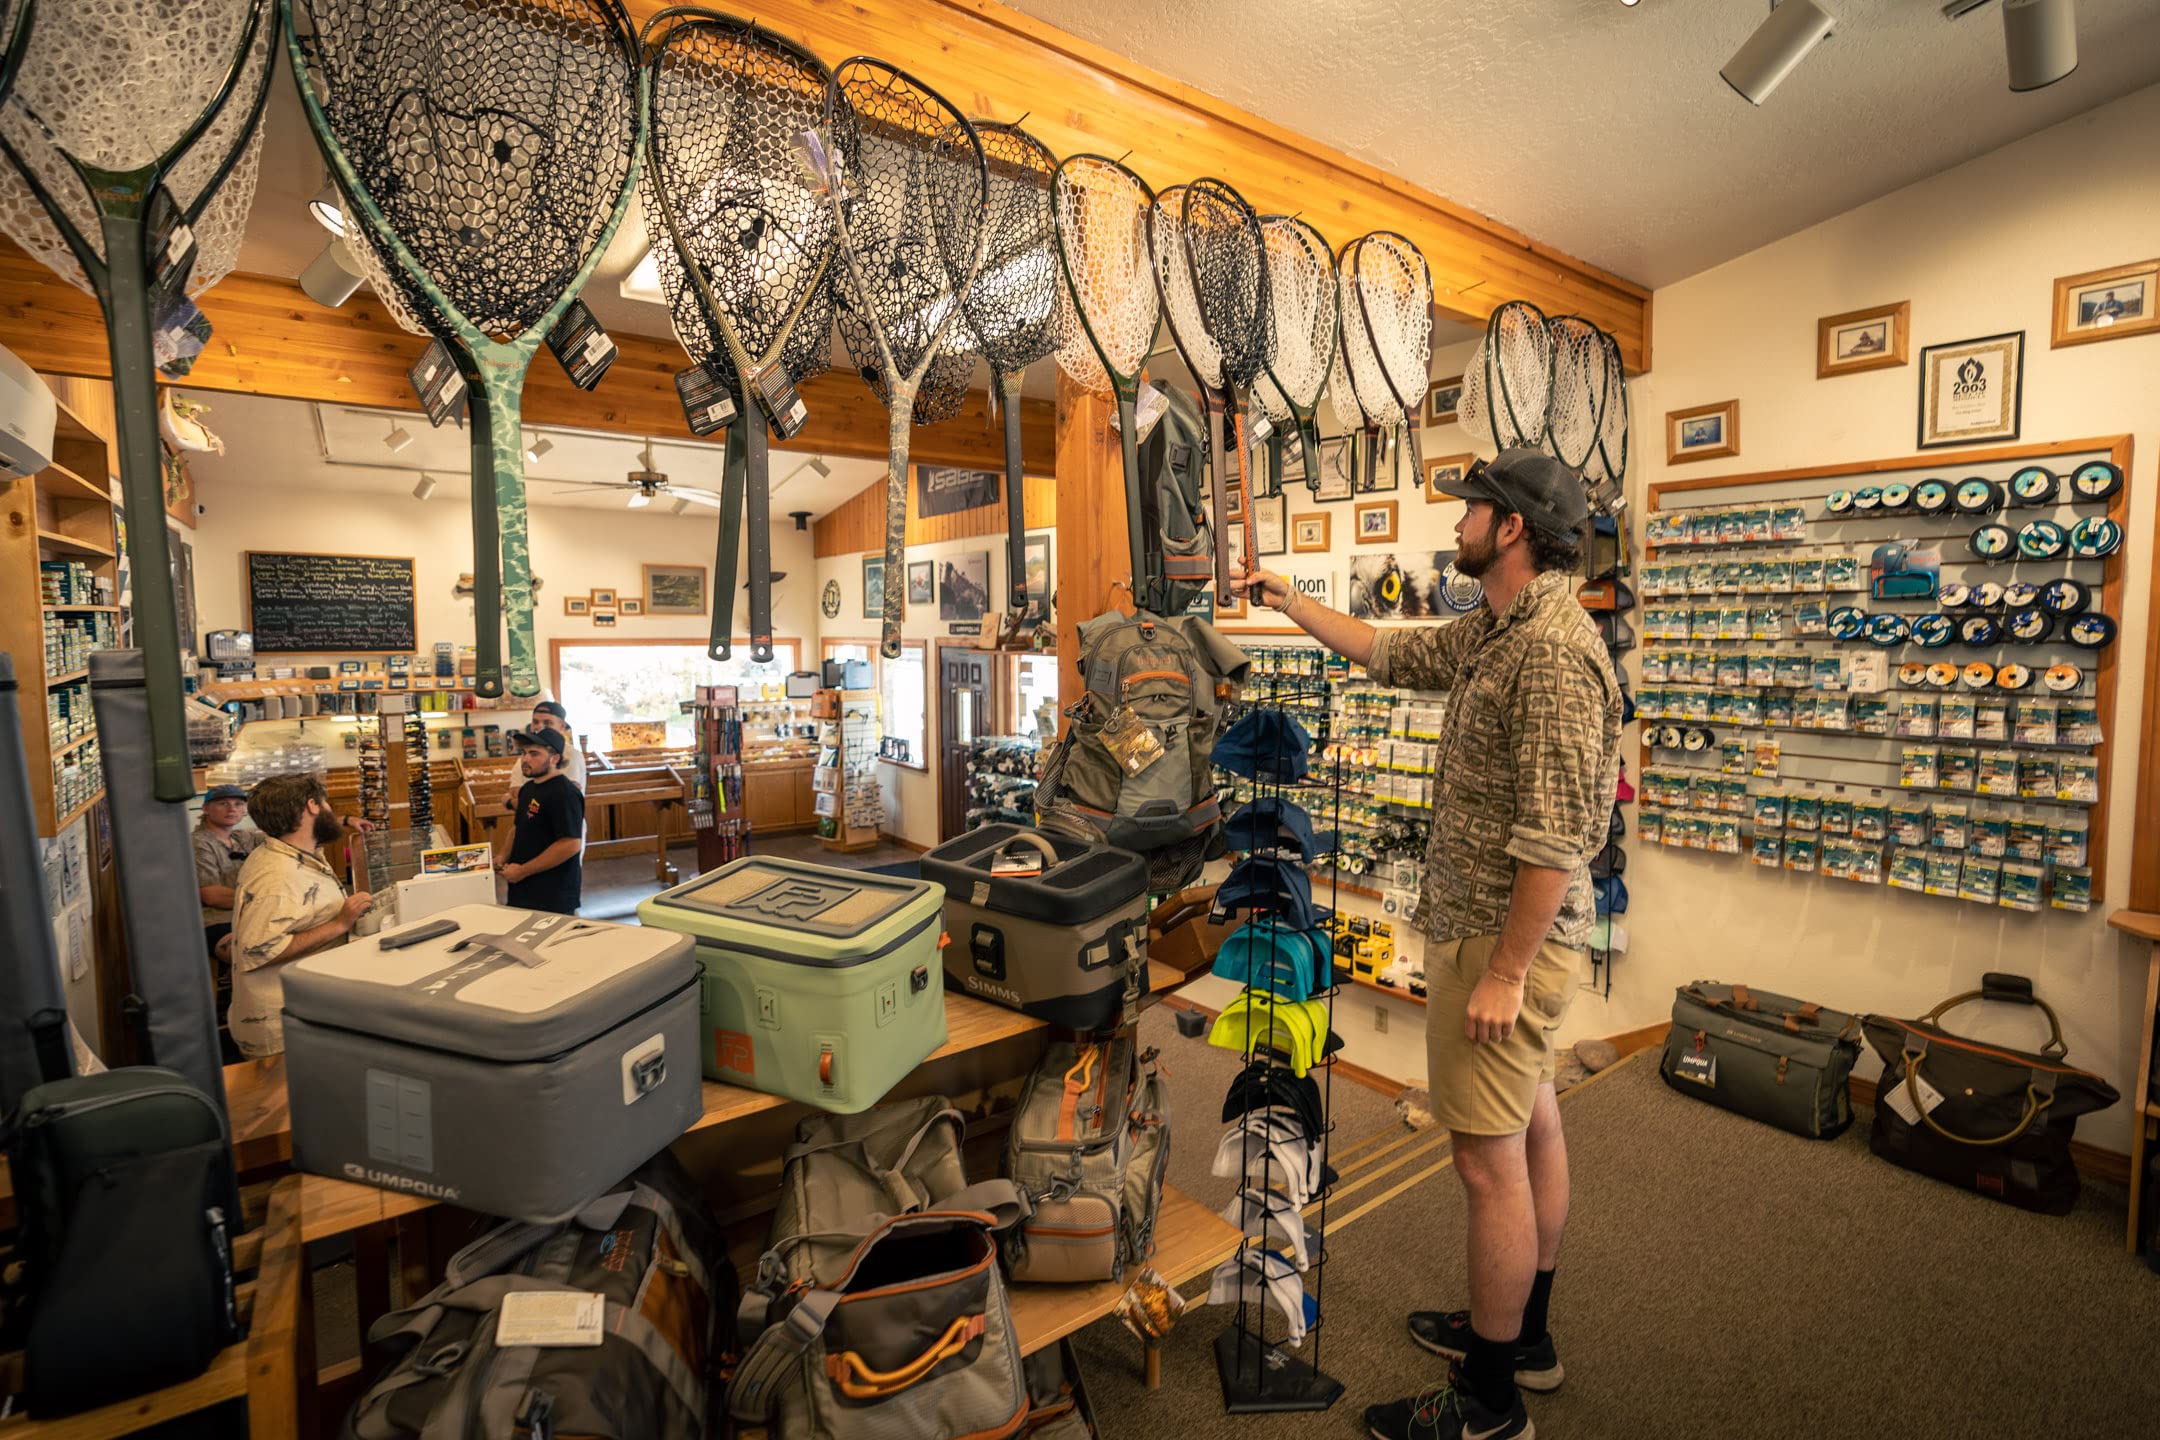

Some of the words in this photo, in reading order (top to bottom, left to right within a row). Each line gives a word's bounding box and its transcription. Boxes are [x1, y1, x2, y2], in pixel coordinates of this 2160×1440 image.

[1953, 379, 1987, 395] 2003
[1293, 574, 1326, 593] loon
[967, 975, 1021, 1003] SIMMS
[367, 1169, 459, 1201] UMPQUA
